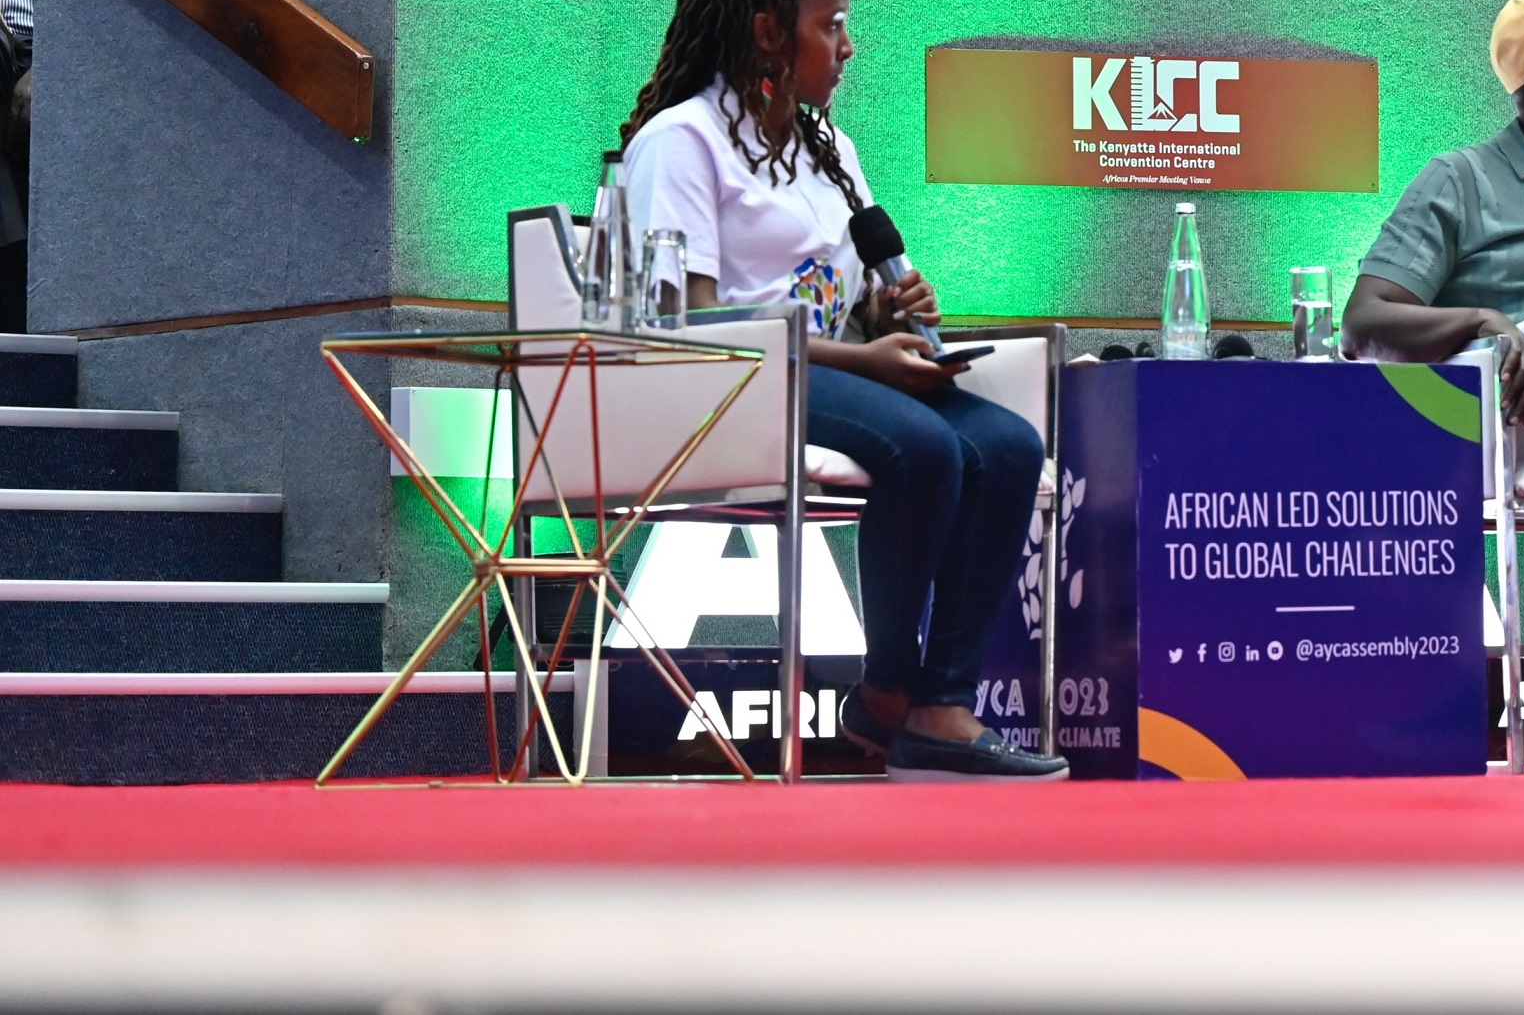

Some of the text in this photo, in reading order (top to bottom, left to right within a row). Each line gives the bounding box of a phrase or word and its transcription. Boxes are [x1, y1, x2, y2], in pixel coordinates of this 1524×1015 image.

[1073, 139, 1241, 156] The Kenyatta International
[1099, 154, 1216, 169] Convention Centre
[1164, 489, 1459, 529] AFRICAN LED SOLUTIONS
[1165, 539, 1456, 580] TO GLOBAL CHALLENGES
[1296, 635, 1460, 662] @aycassembly2023
[973, 677, 1109, 717] YCA 023
[676, 689, 837, 741] AFRI
[1001, 726, 1122, 749] YOUT CLIMATE
